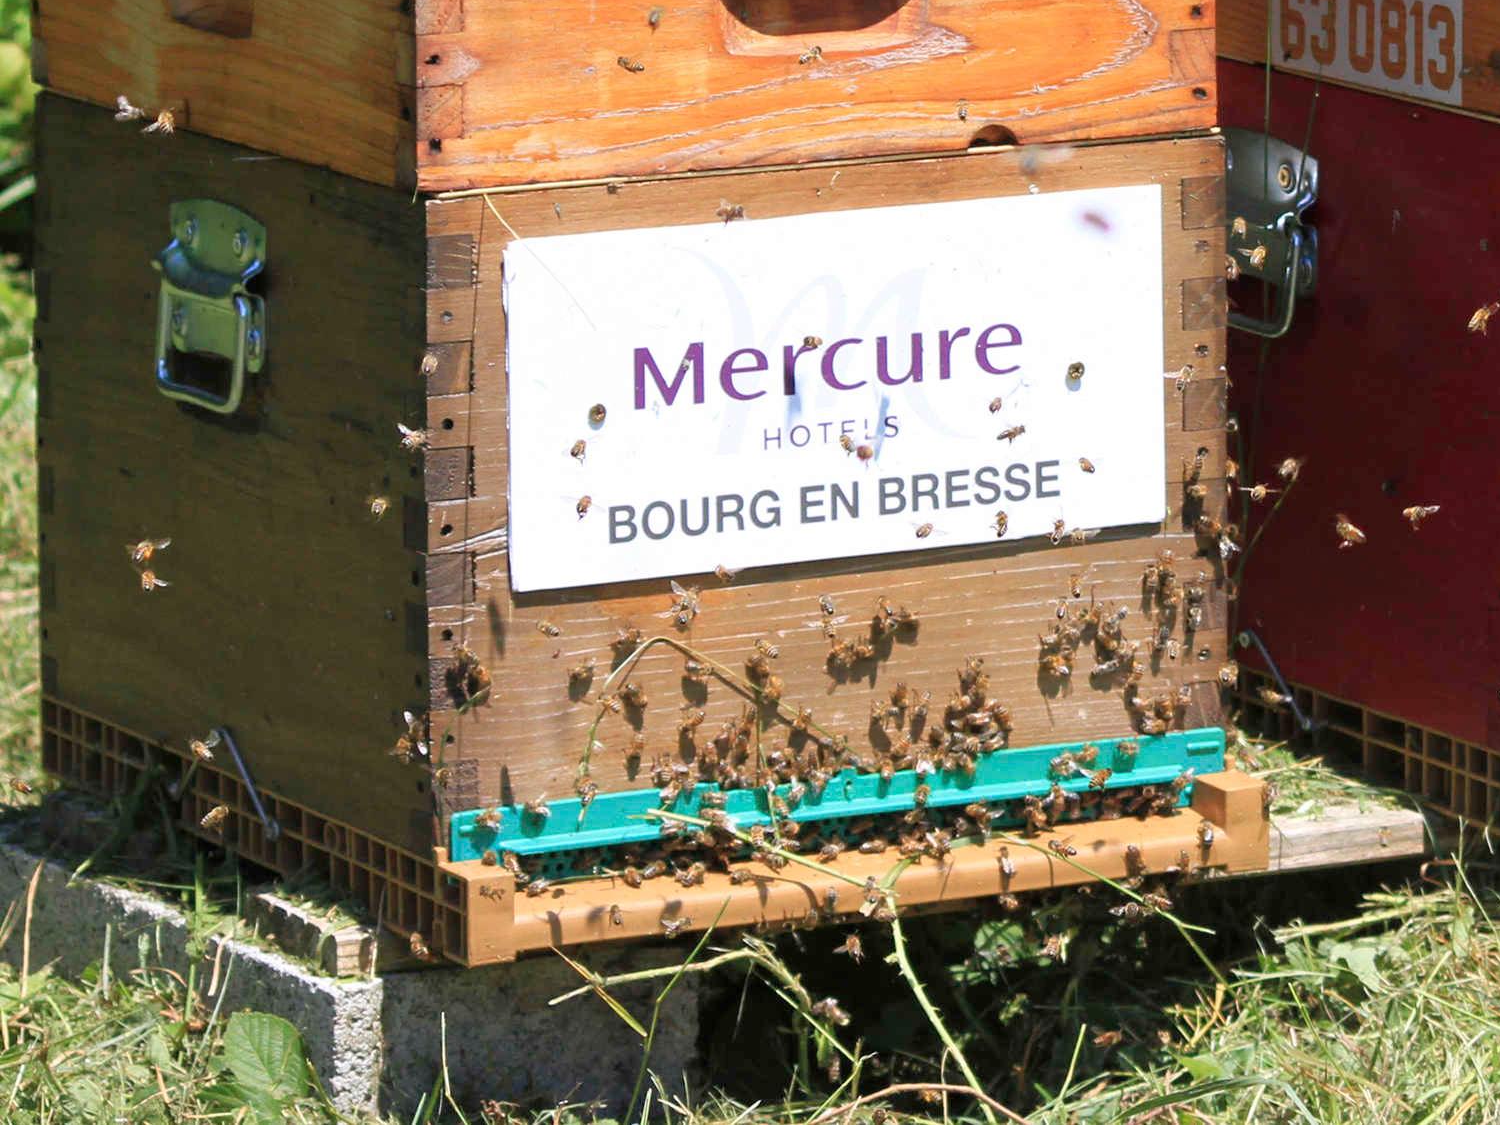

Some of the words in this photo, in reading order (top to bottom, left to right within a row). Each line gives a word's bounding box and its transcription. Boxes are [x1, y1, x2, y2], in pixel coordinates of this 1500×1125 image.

[634, 323, 1023, 410] Mercure
[764, 416, 899, 450] HOTELS
[608, 490, 781, 544] BOURG
[801, 481, 860, 524] EN
[879, 460, 1060, 515] BRESSE
